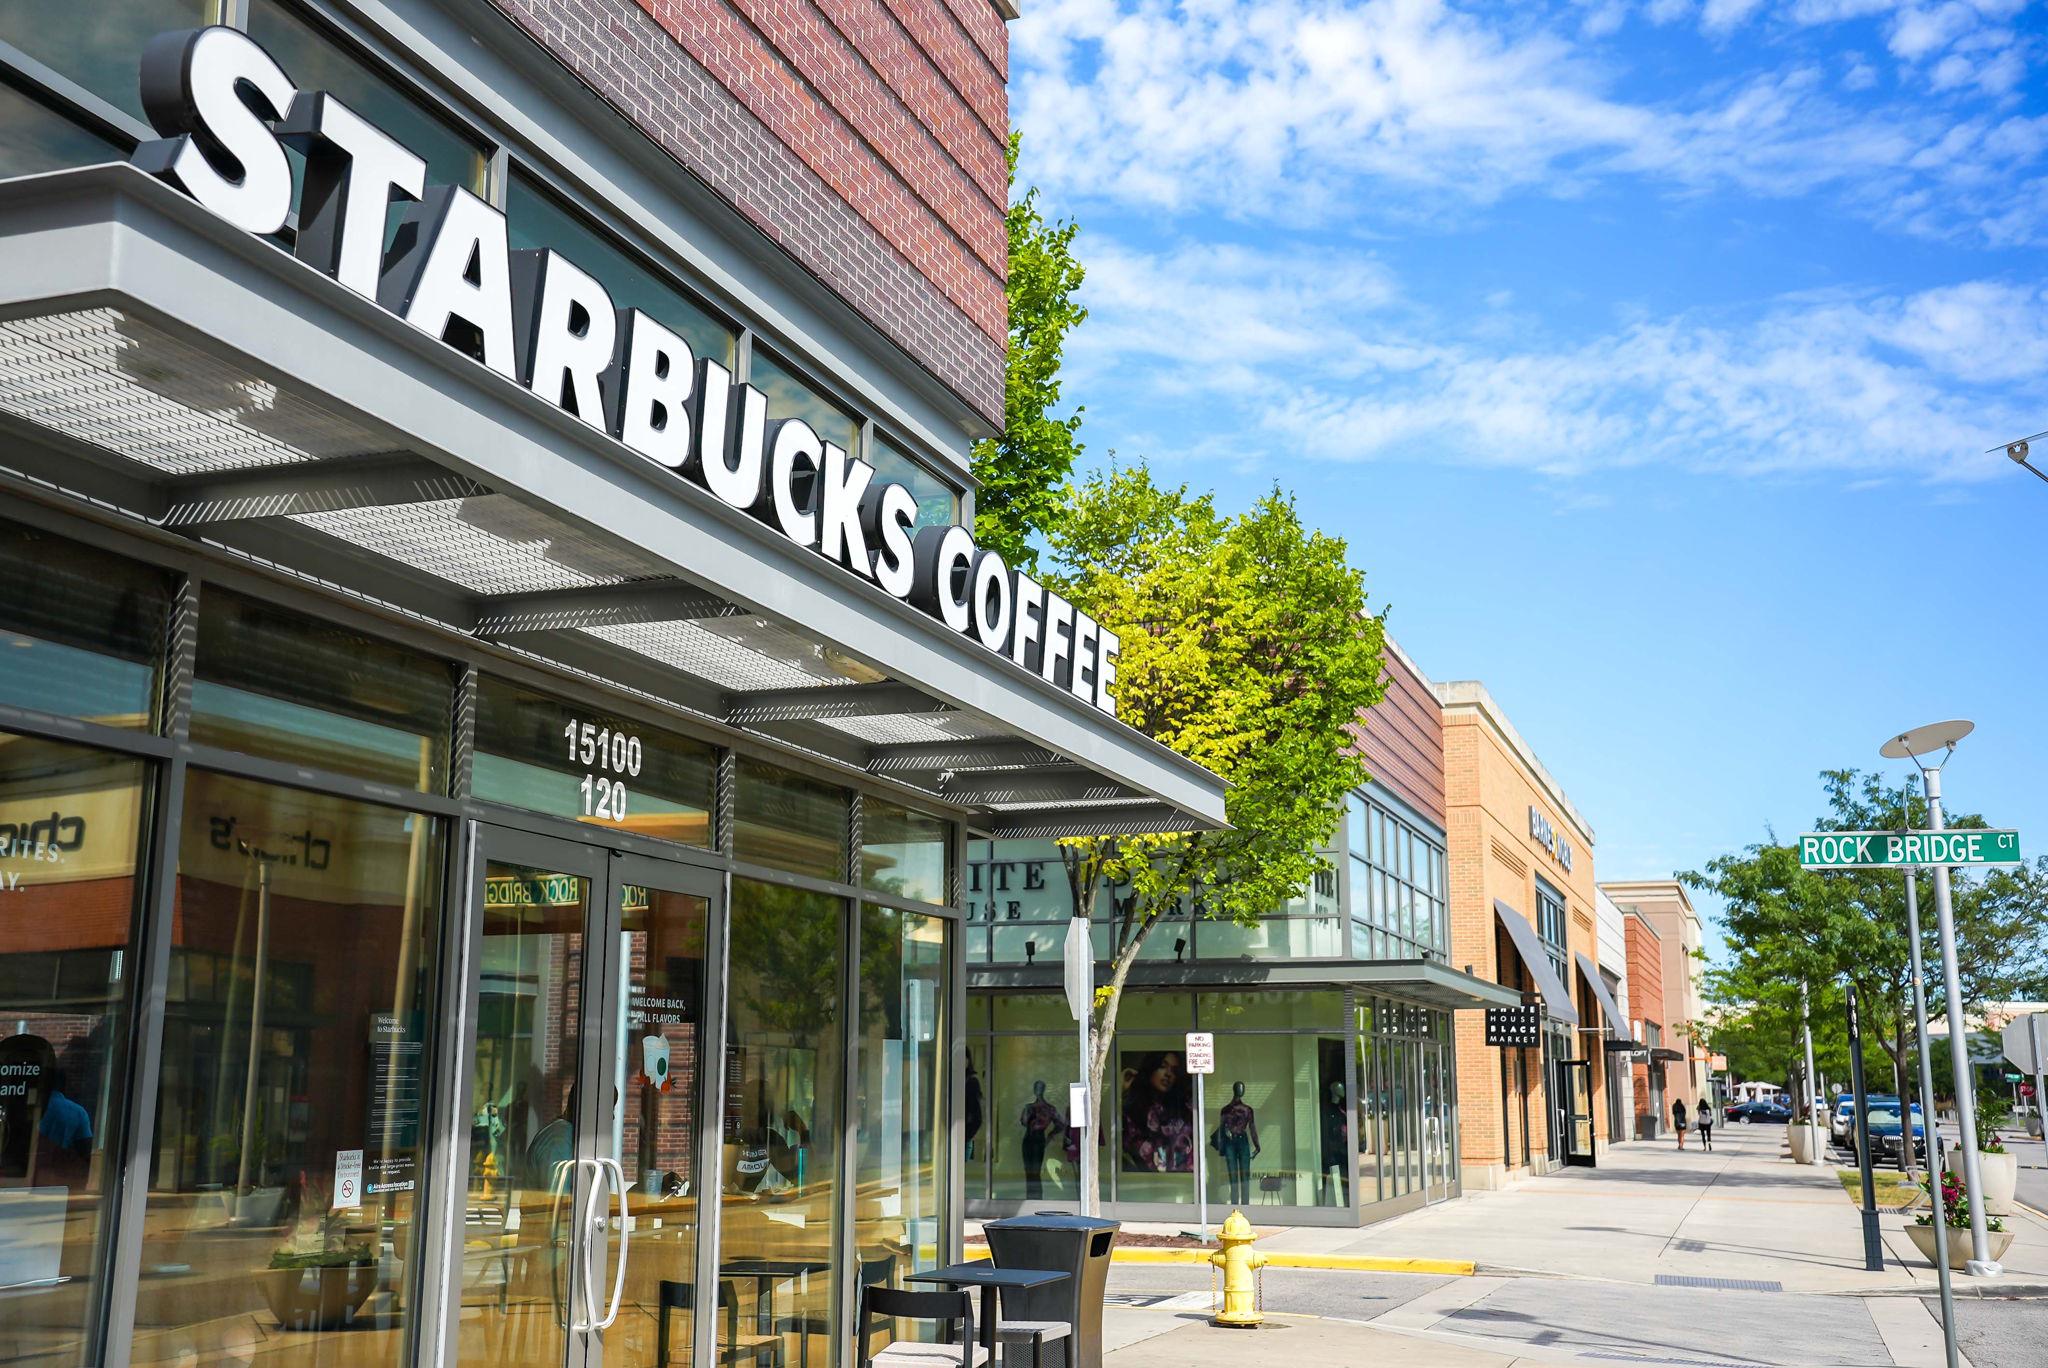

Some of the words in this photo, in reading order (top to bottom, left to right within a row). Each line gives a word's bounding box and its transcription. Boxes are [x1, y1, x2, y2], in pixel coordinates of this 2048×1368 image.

[178, 24, 918, 599] STARBUCKS
[934, 524, 1121, 718] COFFEE
[564, 718, 642, 777] 15100
[581, 773, 627, 822] 120
[1803, 837, 1874, 864] ROCK
[1887, 834, 1985, 862] BRIDGE
[1997, 834, 2015, 849] CT
[632, 997, 666, 1008] WELCOME
[667, 999, 686, 1011] BACK,
[652, 1013, 680, 1024] FLAVORS
[0, 1081, 26, 1096] and
